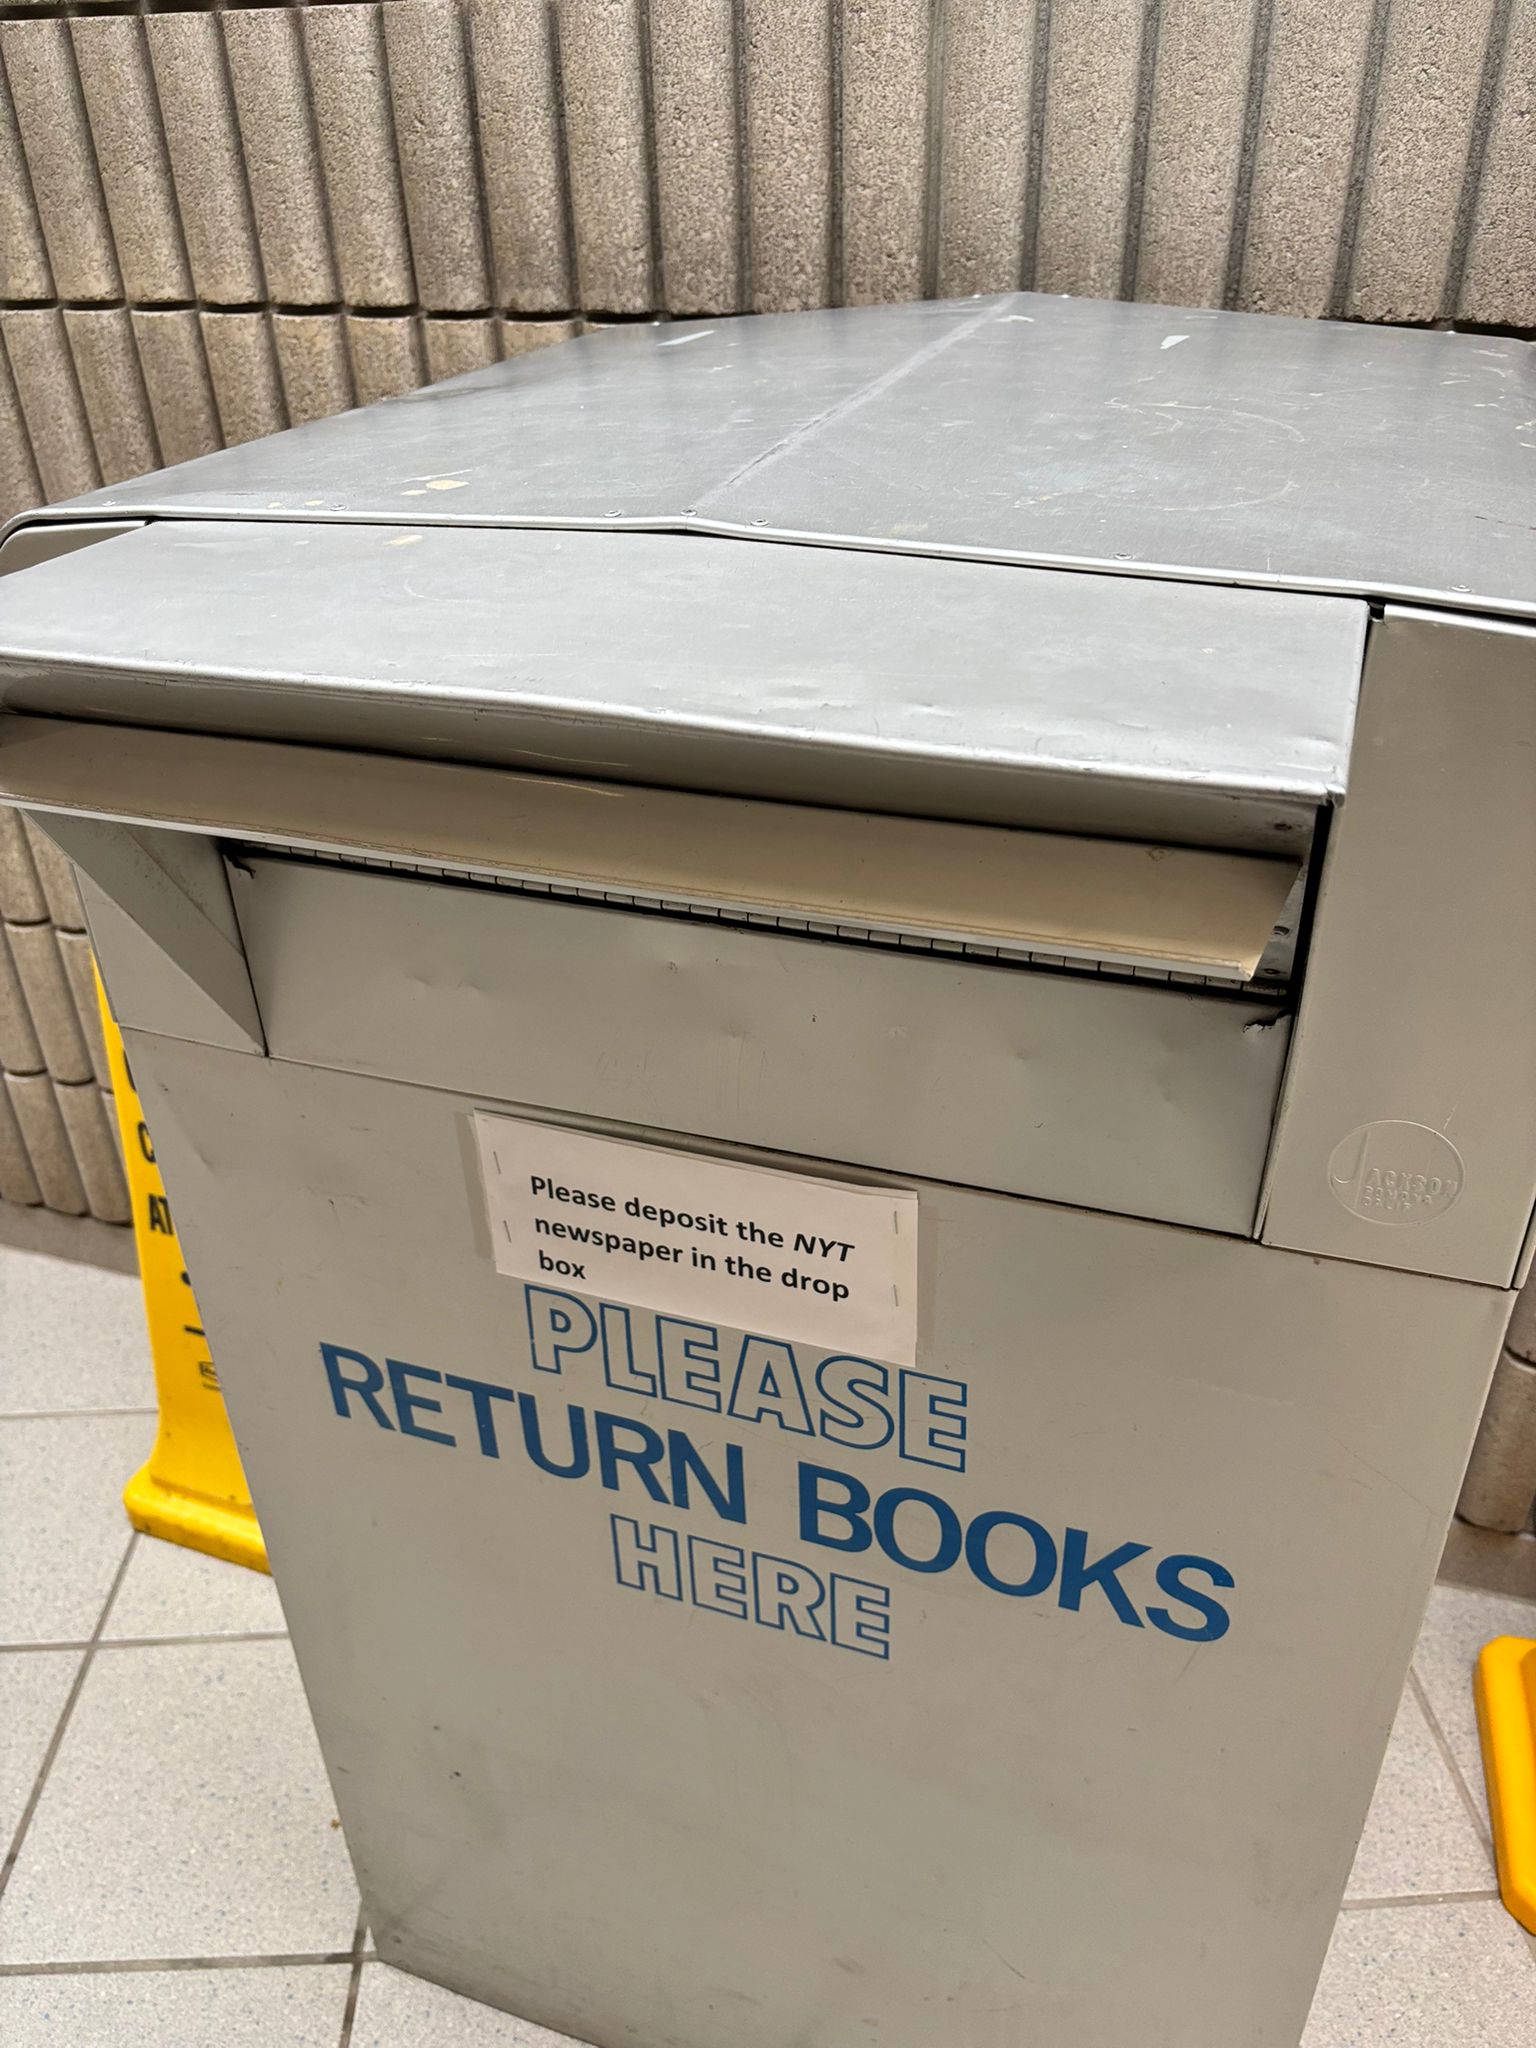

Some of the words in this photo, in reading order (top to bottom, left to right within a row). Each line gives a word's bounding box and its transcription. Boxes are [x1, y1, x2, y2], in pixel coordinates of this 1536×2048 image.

[530, 1176, 616, 1212] Please
[624, 1198, 728, 1237] deposit
[736, 1222, 785, 1248] the
[793, 1233, 855, 1263] NYT
[534, 1217, 683, 1263] newspaper
[691, 1247, 717, 1270] in
[724, 1256, 772, 1283] the
[780, 1268, 850, 1302] drop
[539, 1249, 586, 1280] box
[524, 1284, 968, 1473] PLEASE
[319, 1342, 747, 1525] RETURN
[797, 1461, 1236, 1643] BOOKS
[609, 1514, 891, 1660] HERE
